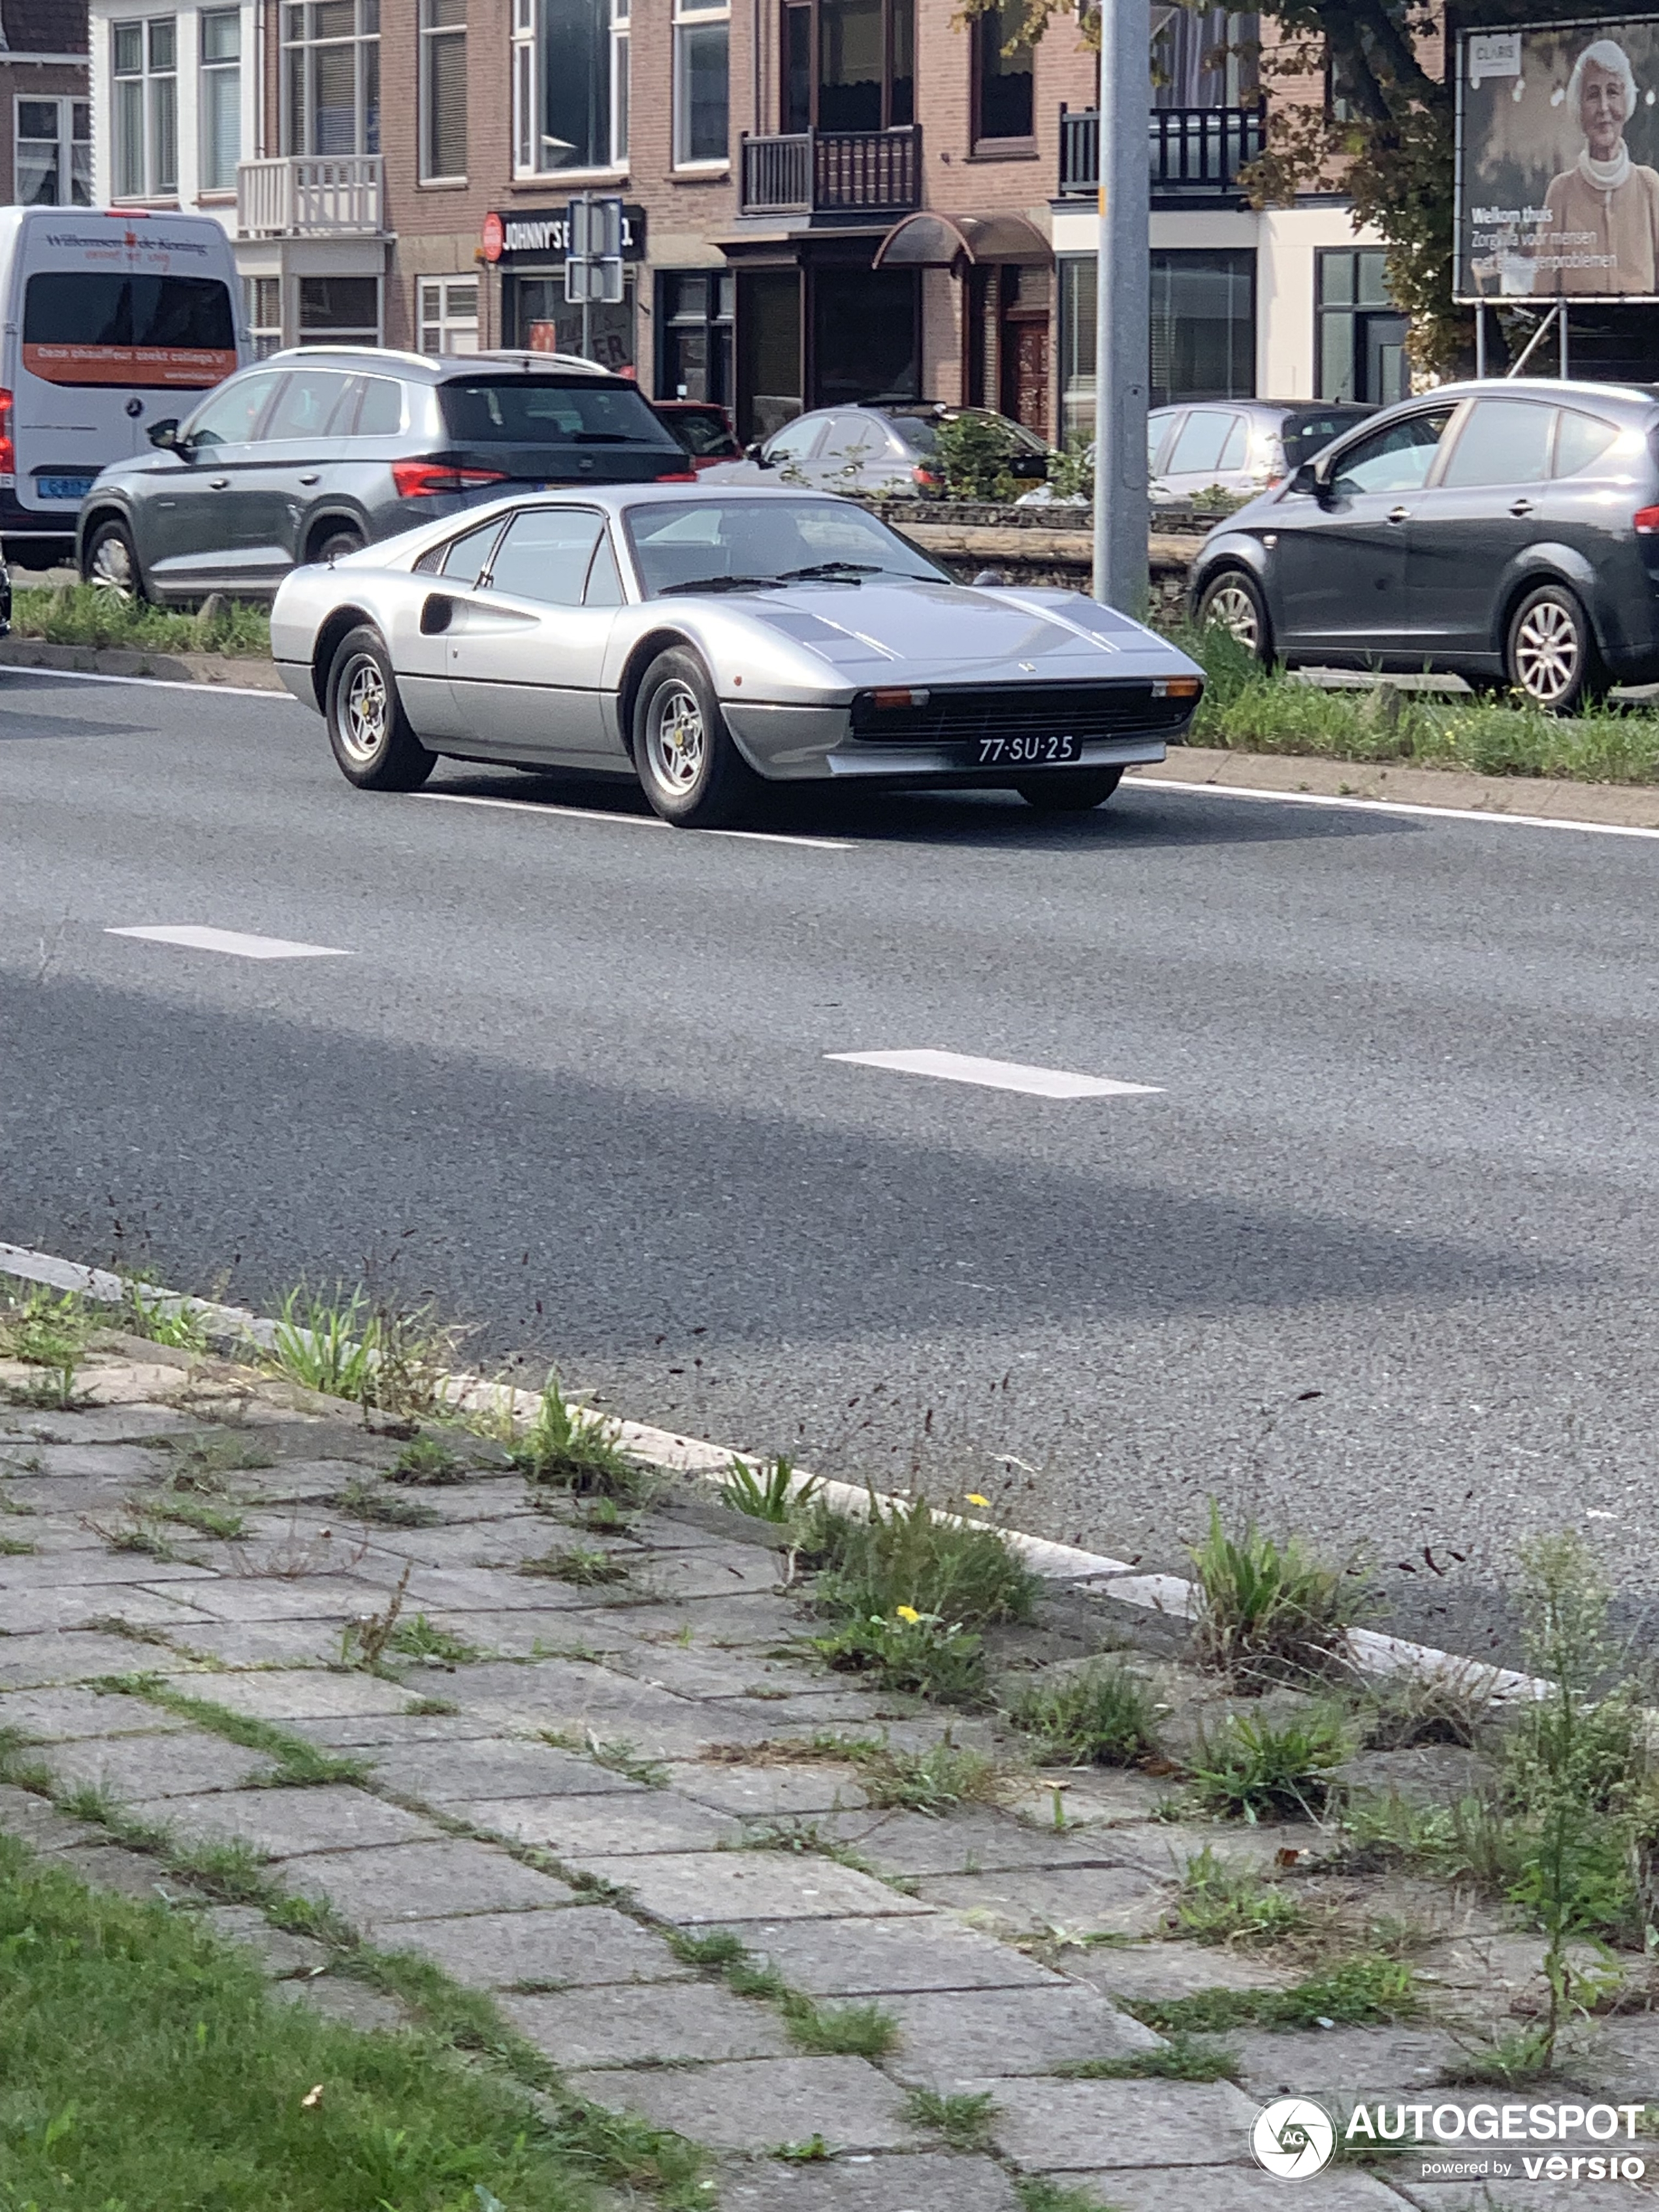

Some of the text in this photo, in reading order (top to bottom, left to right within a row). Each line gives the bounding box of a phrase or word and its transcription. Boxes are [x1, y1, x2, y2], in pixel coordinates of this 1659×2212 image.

[1472, 206, 1553, 223] Welkom thuis
[503, 221, 562, 249] JOHNNY'S
[1521, 233, 1547, 246] voor
[1550, 231, 1598, 246] mensen
[980, 736, 1072, 762] 77-SU-25
